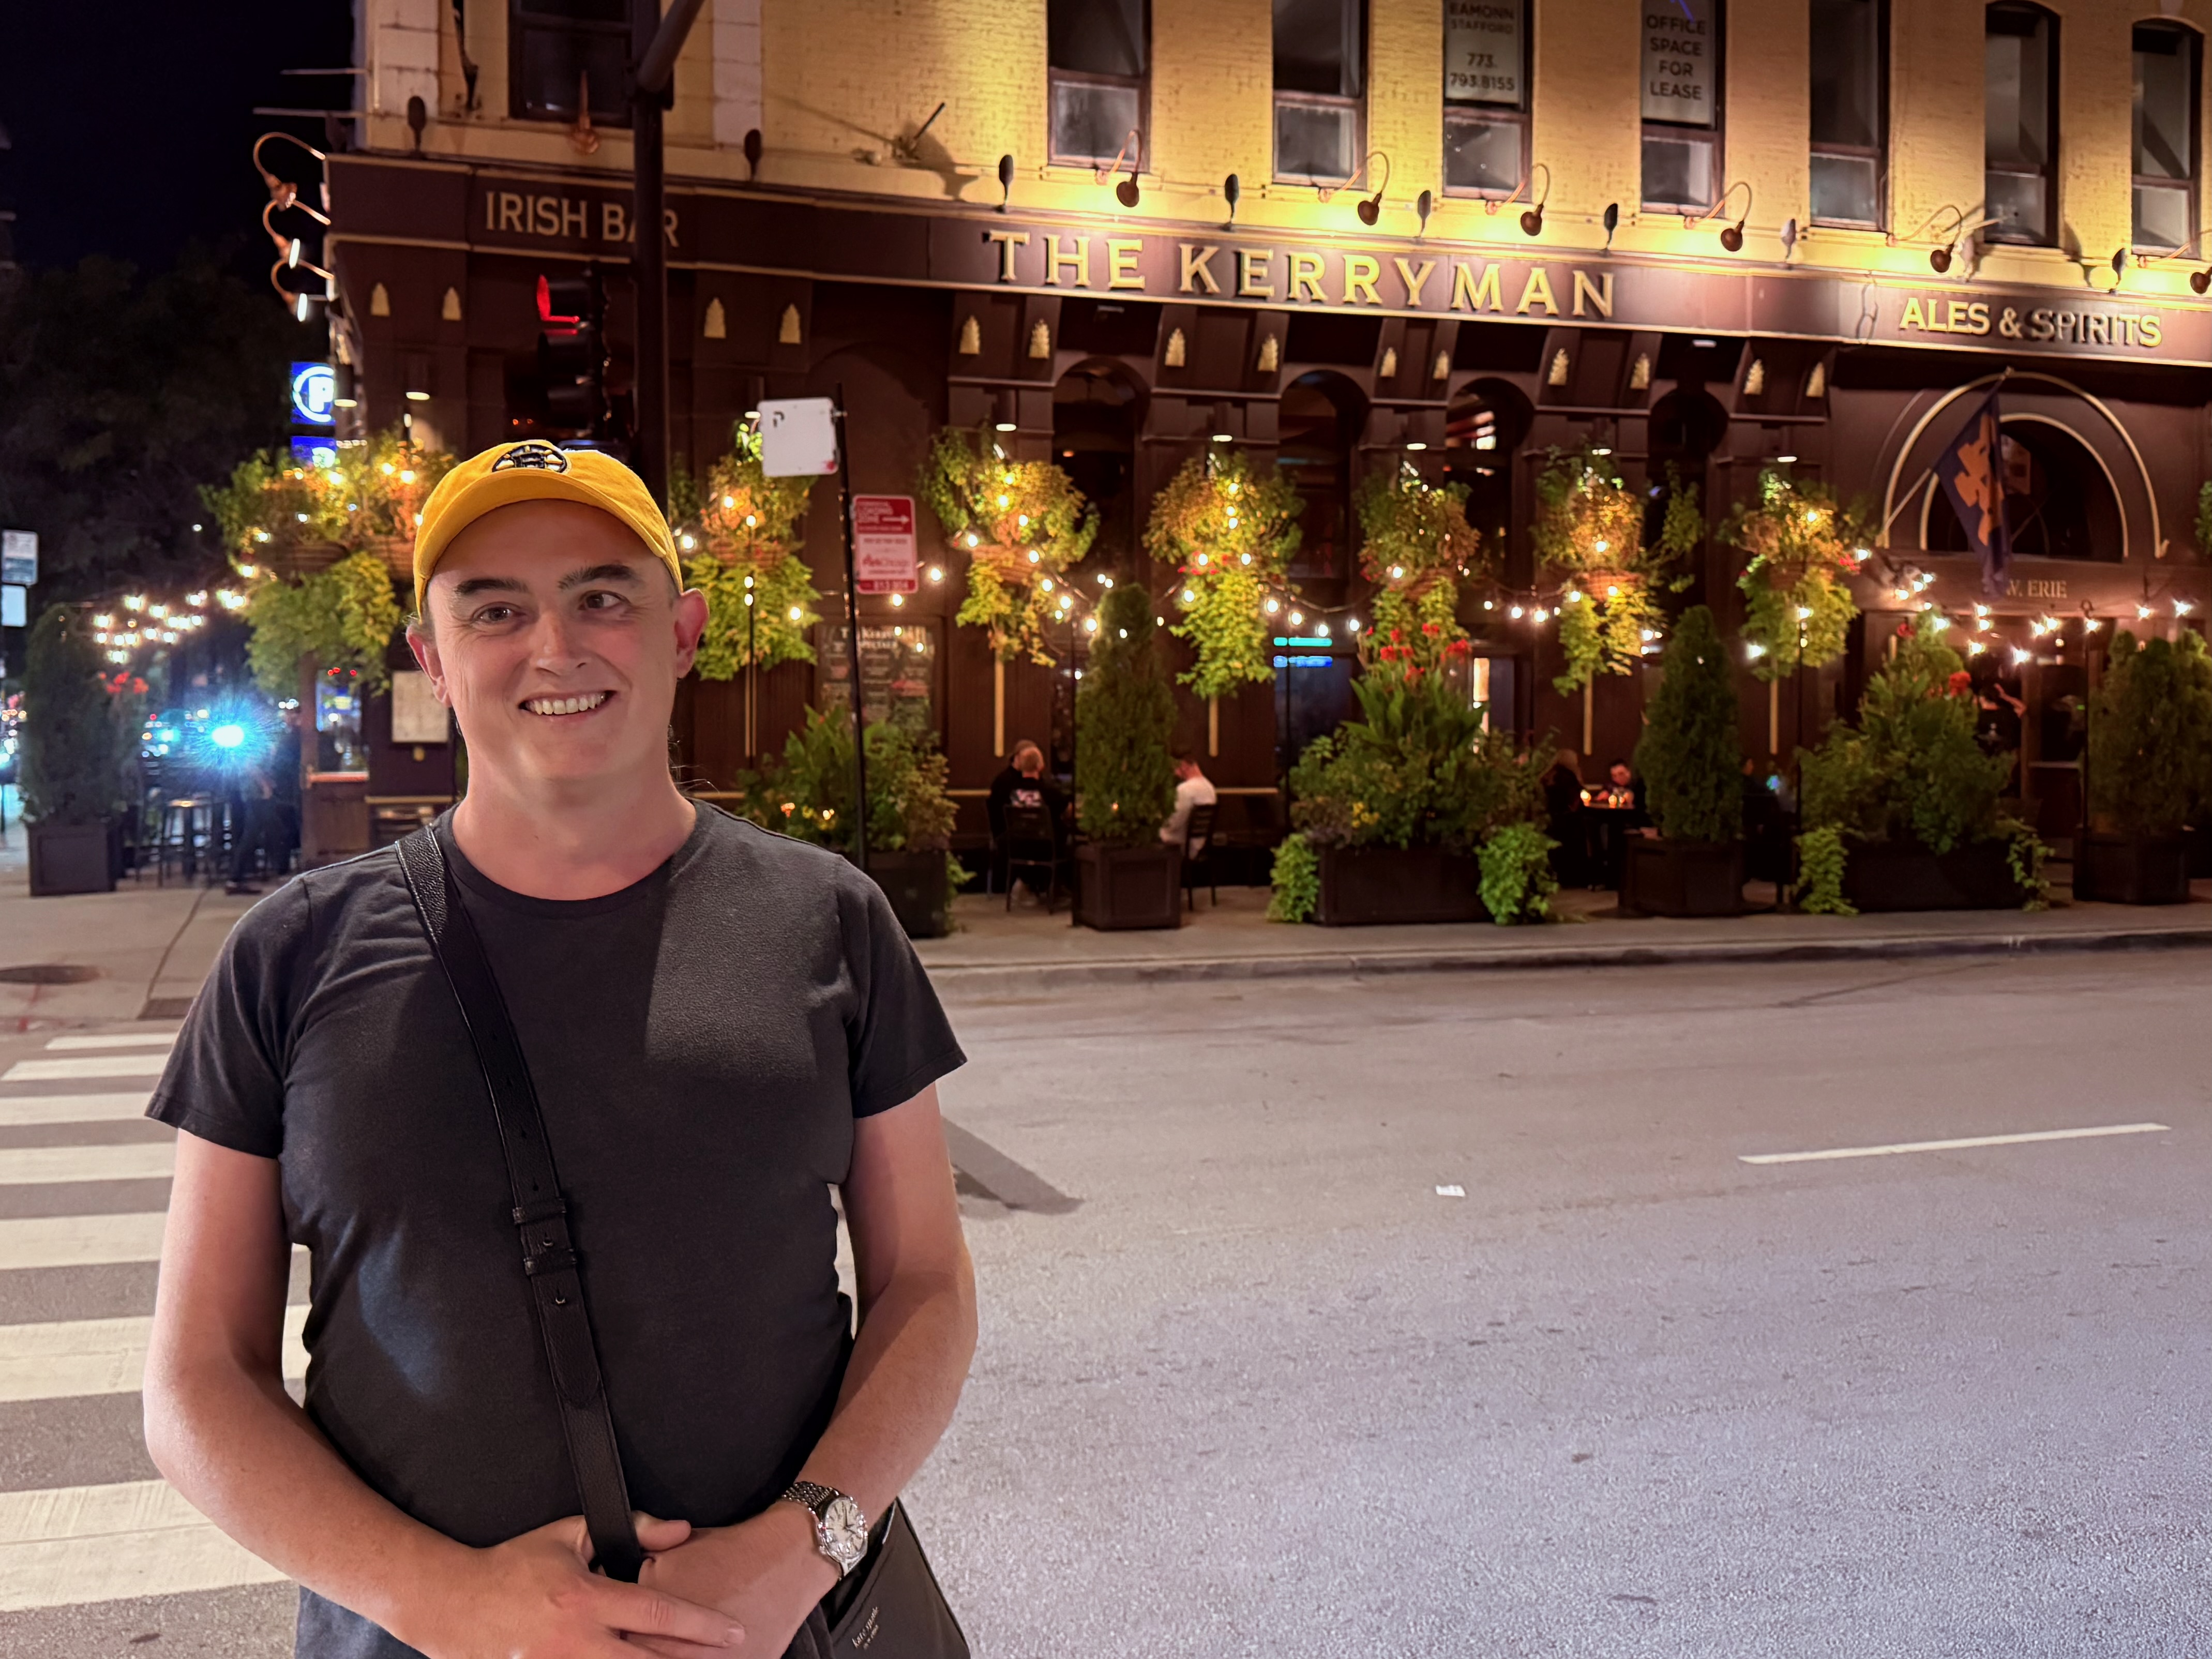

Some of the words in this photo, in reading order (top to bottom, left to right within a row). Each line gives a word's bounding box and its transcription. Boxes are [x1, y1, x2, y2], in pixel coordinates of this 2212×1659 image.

[1646, 14, 1706, 35] OFFICE
[1650, 37, 1703, 56] SPACE
[1659, 60, 1694, 77] FOR
[1650, 81, 1702, 100] LEASE
[486, 191, 588, 238] IRISH
[988, 229, 1146, 290] THE
[1178, 243, 1614, 318] KERRYMAN
[1900, 297, 1991, 336] ALES
[1999, 307, 2023, 338] &
[2031, 307, 2162, 347] SPIRITS
[2027, 579, 2068, 599] ERIE
